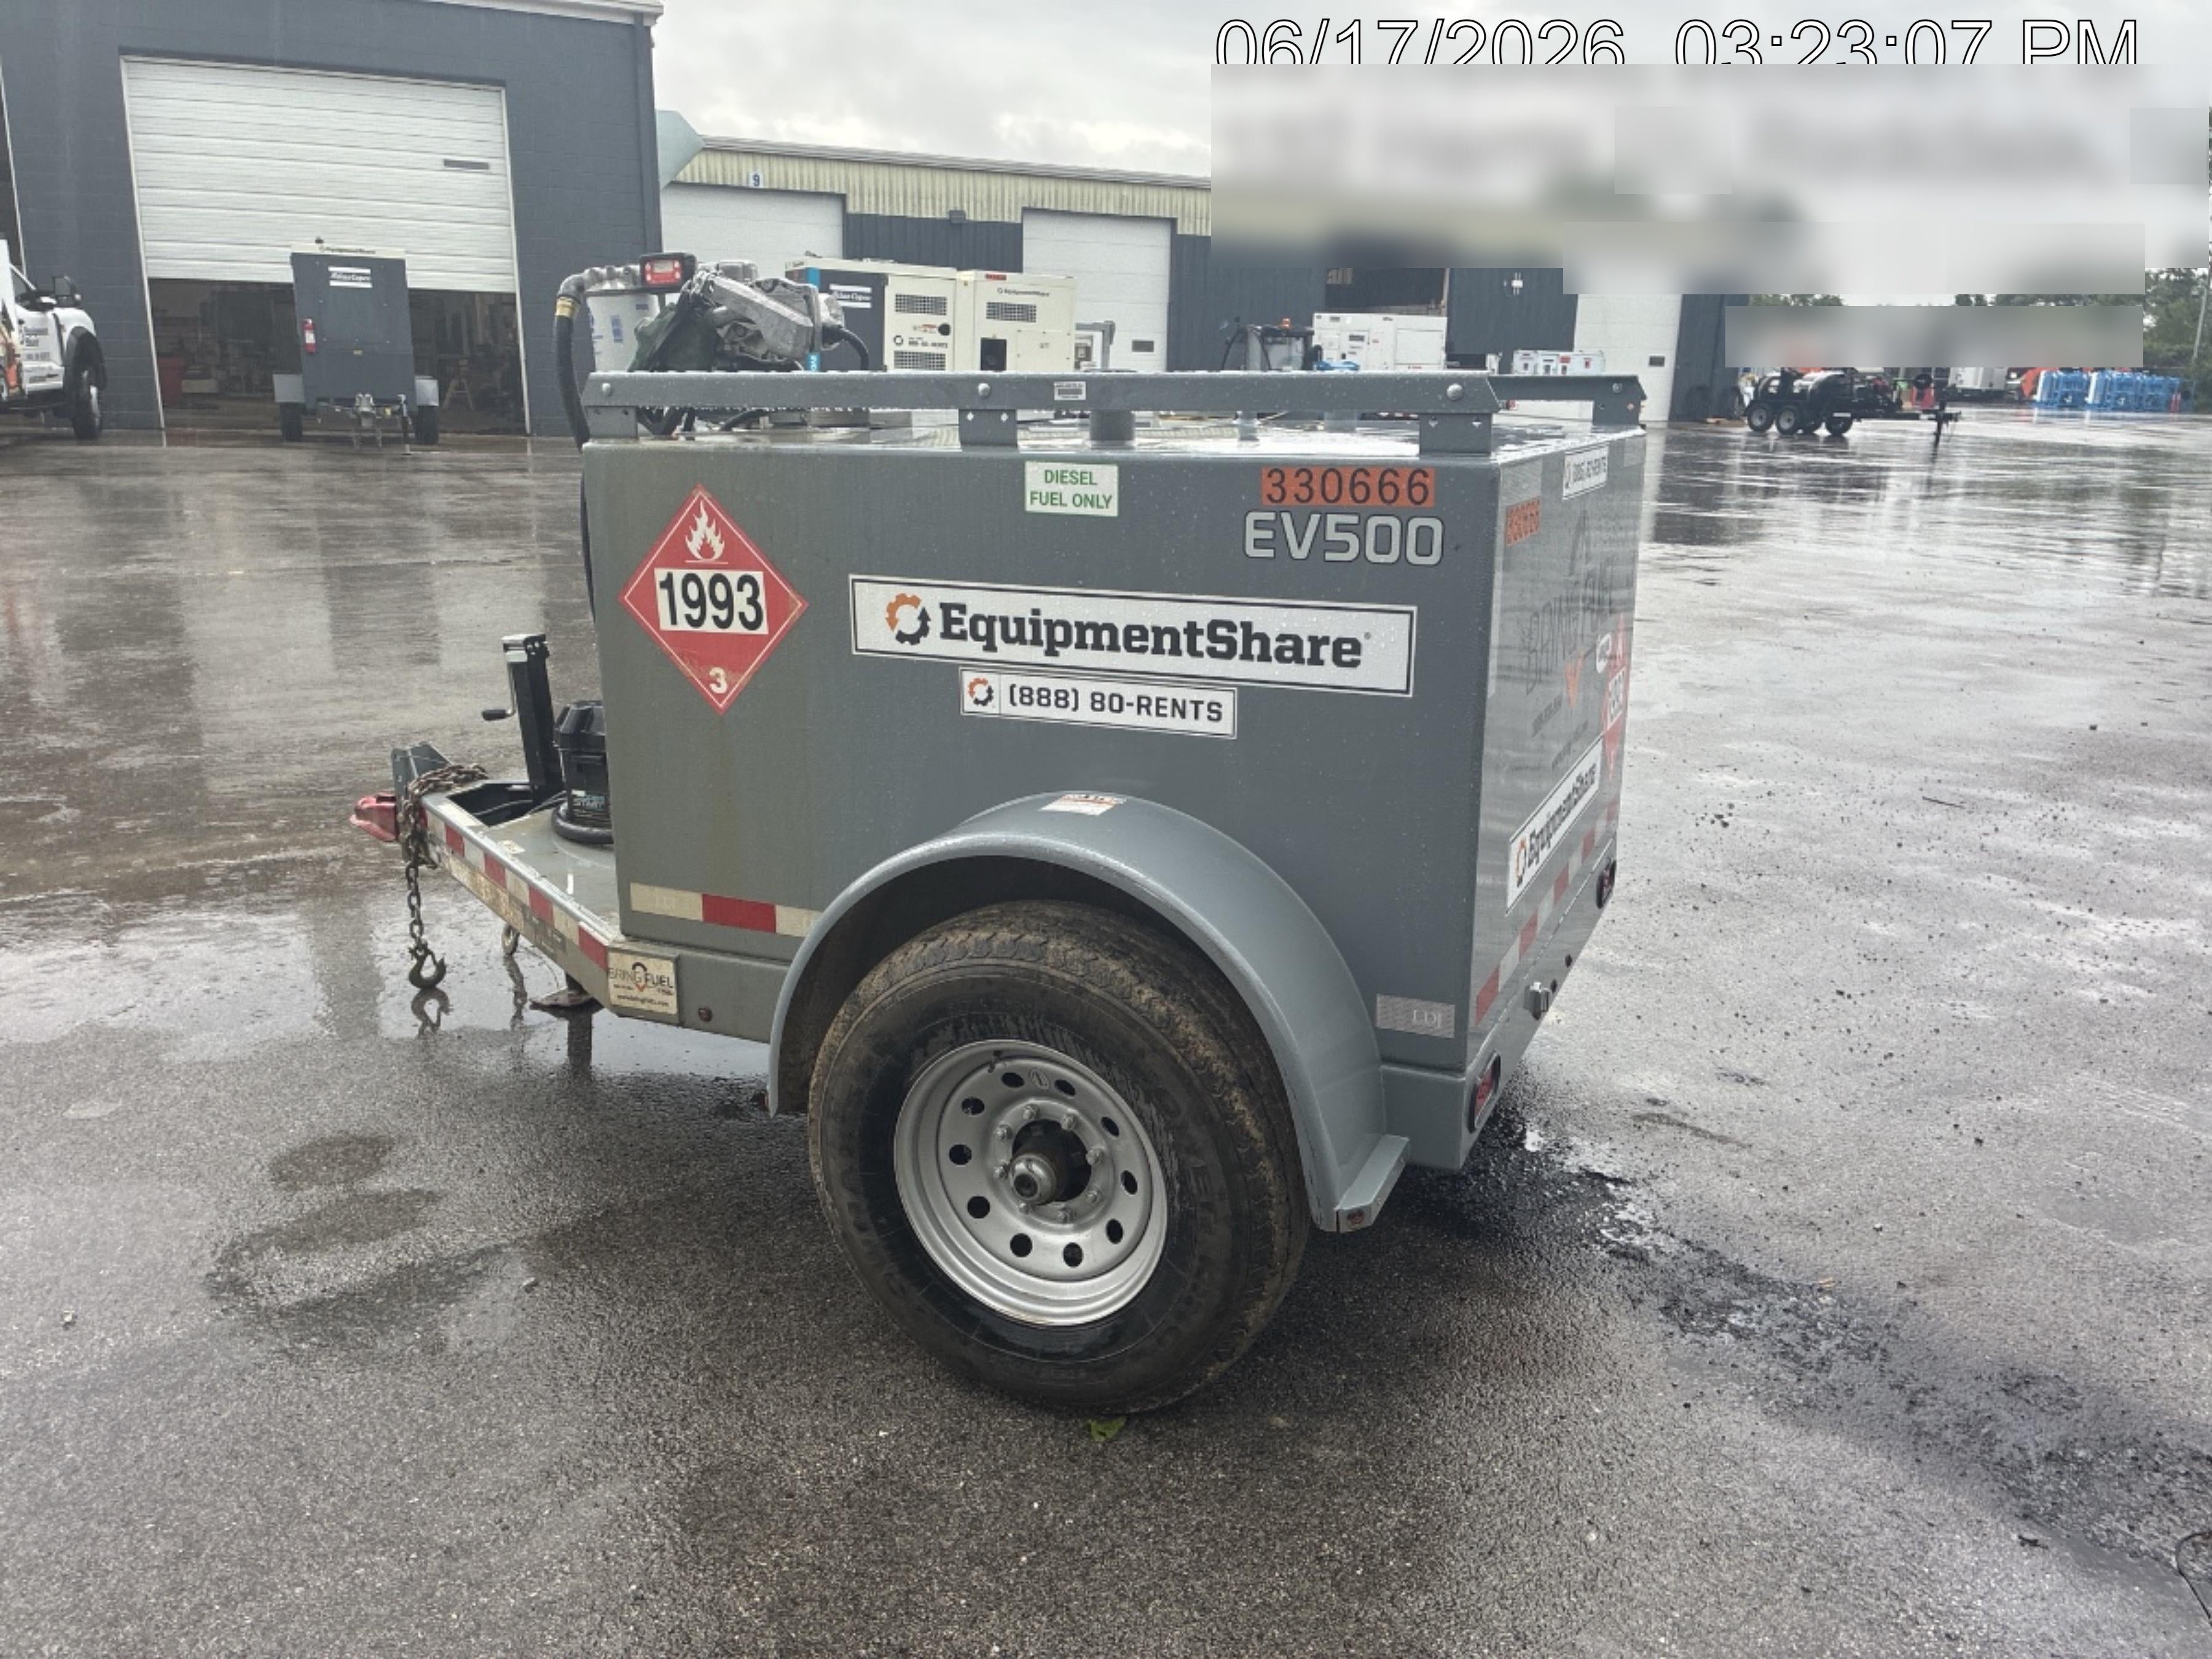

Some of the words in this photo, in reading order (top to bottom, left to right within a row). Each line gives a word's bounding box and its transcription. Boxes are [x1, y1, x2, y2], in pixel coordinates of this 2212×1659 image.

[1045, 469, 1097, 485] DIESEL
[1266, 468, 1430, 505] 330666
[1030, 491, 1067, 507] FUEL
[1072, 493, 1113, 509] ONLY
[1244, 510, 1444, 566] EV500
[659, 571, 764, 631] 1993
[939, 602, 1362, 668] EquipmentShare
[708, 667, 728, 694] 3
[1010, 683, 1079, 712] (888)
[1090, 692, 1223, 723] 80-RENTS
